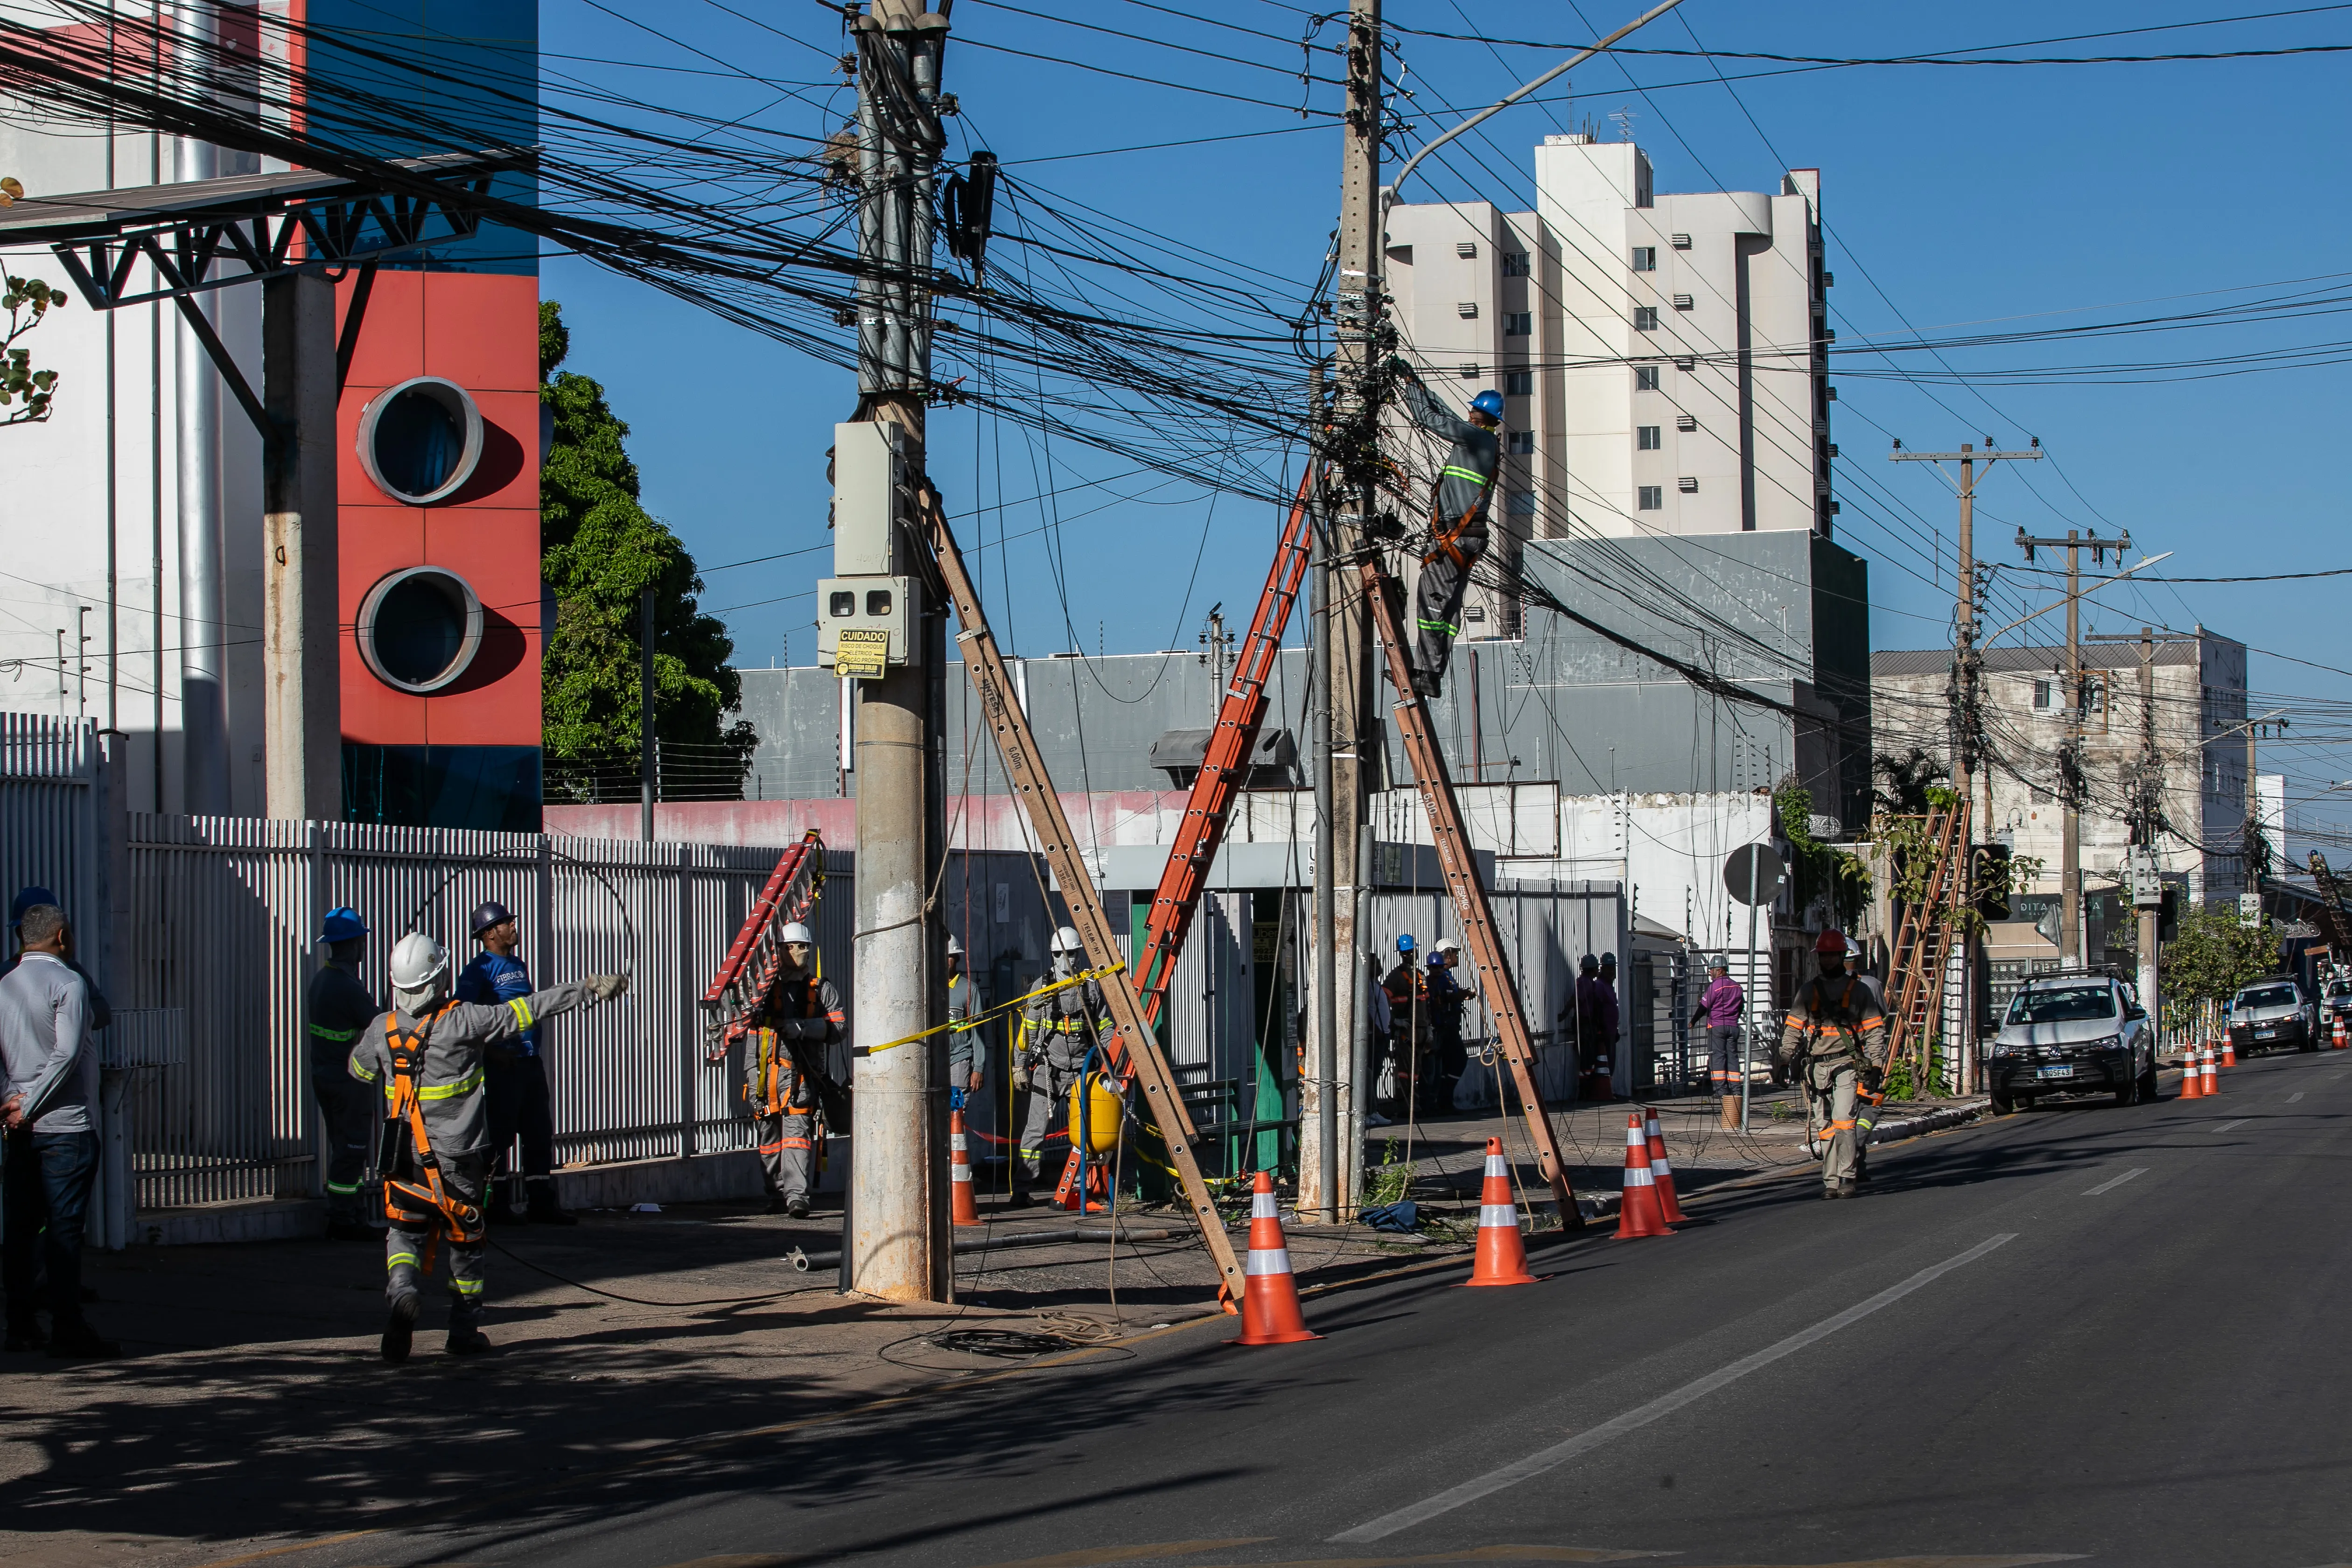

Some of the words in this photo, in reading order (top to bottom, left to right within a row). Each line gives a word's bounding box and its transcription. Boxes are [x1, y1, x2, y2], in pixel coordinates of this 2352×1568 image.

[841, 631, 885, 642] CUIDADO
[1441, 838, 1453, 864] TELEMONT
[1455, 885, 1470, 910] ESMIG
[1083, 922, 1101, 955] TELEMONT
